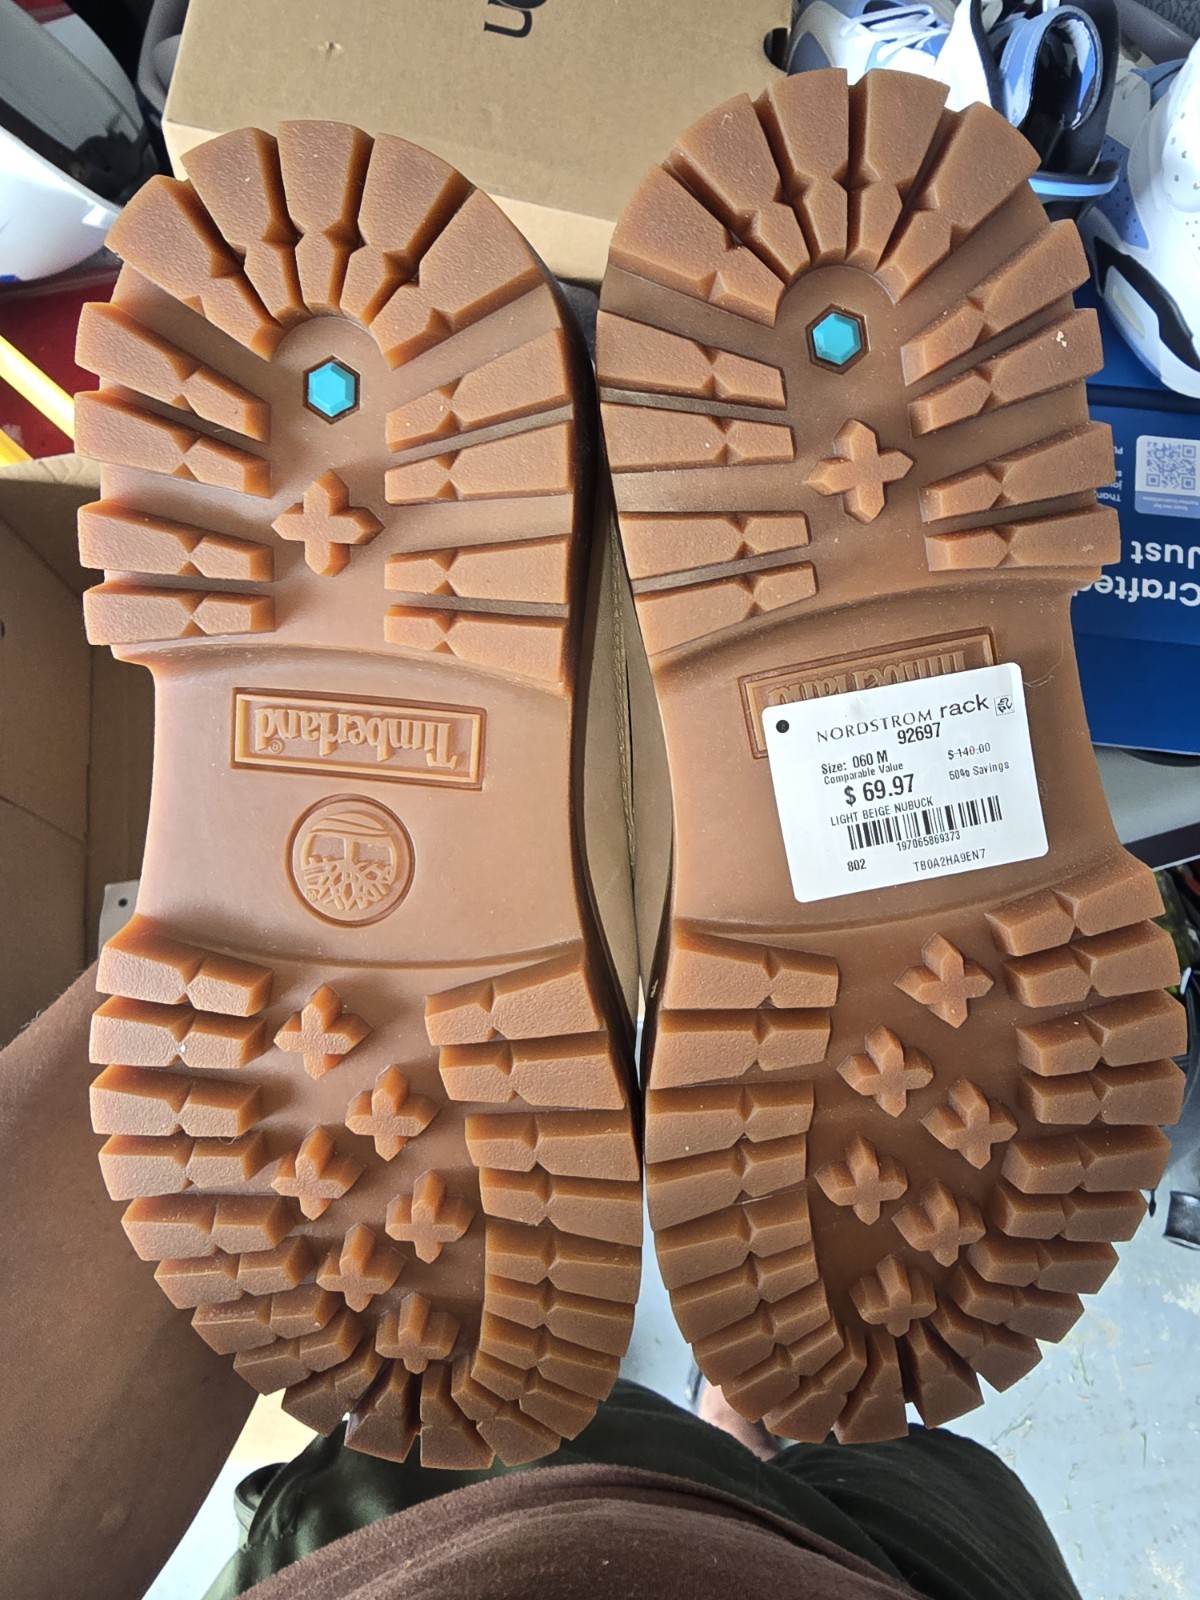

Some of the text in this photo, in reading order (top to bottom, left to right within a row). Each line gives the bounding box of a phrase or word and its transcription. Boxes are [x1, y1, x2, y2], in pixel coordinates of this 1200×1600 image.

[1131, 541, 1200, 570] Just
[816, 693, 990, 743] NORDSTROM rack
[897, 721, 941, 745] 92697
[821, 749, 889, 775] Size: 060 M
[823, 762, 904, 785] Comparable Value
[948, 761, 1010, 781] 50% Savings
[862, 772, 914, 802] 69.97
[830, 796, 934, 827] LIGHT BEIGE NUBUCK
[896, 830, 961, 852] 197065869373
[847, 858, 867, 872] 802
